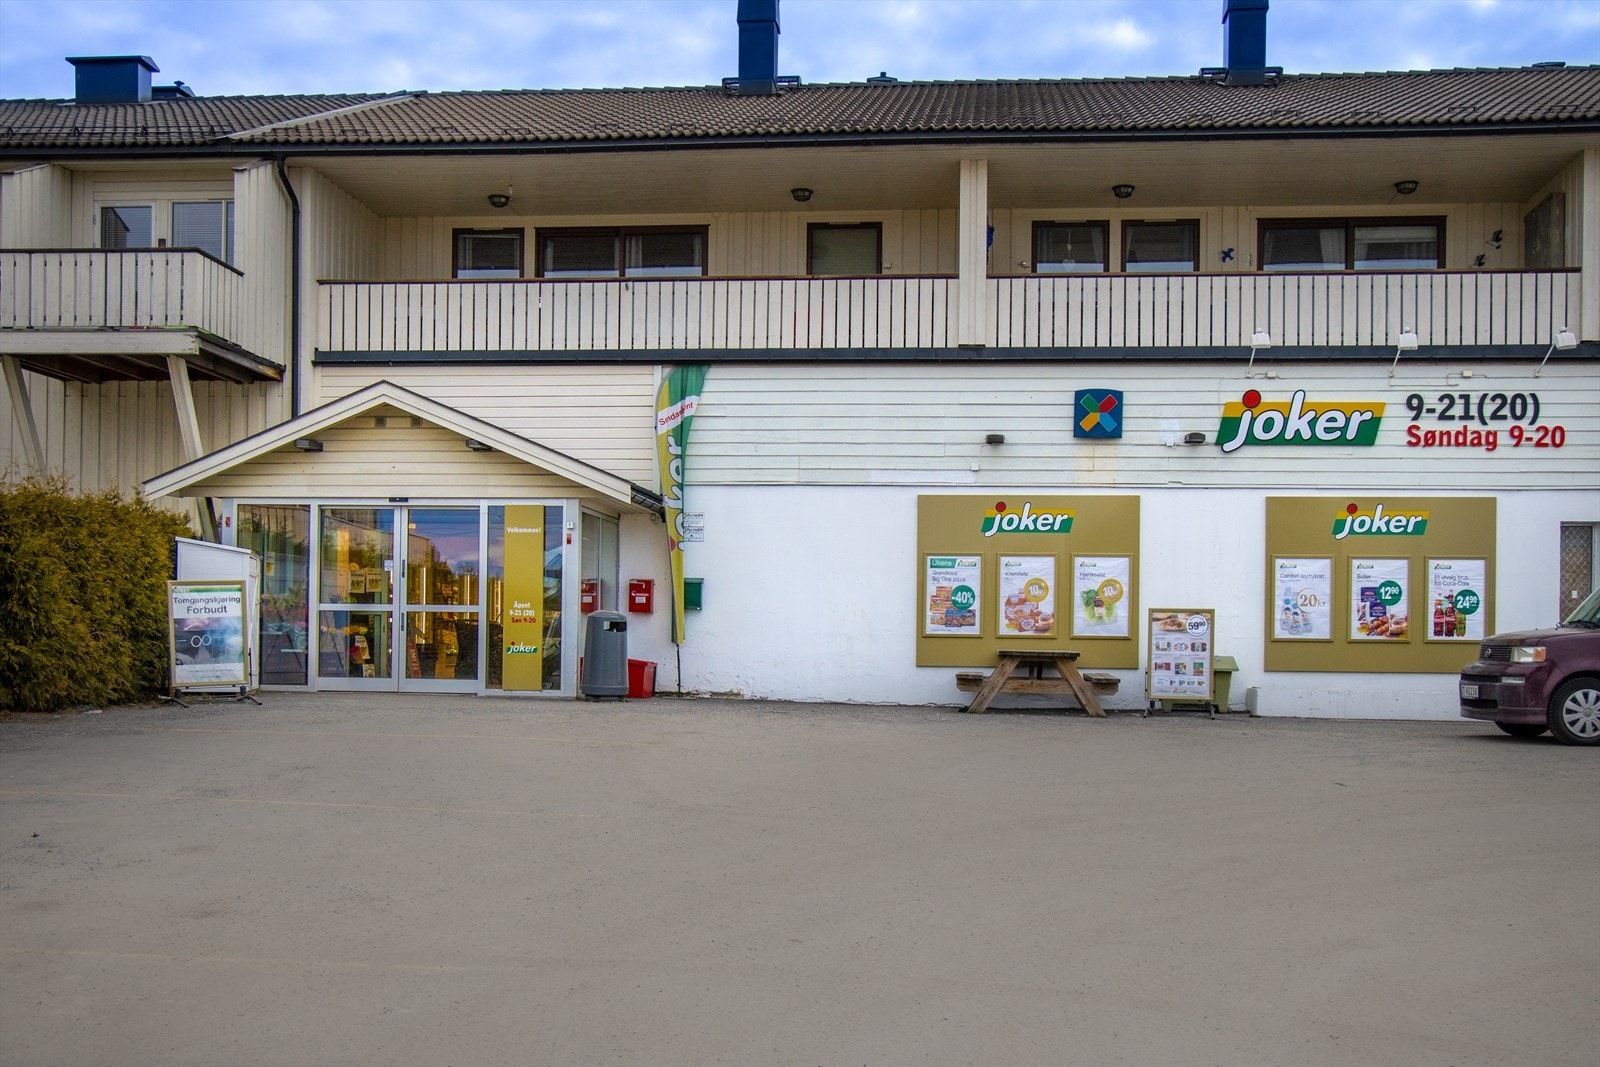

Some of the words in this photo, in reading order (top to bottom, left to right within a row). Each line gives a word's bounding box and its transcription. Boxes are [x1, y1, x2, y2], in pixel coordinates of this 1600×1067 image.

[1406, 393, 1540, 425] 9-21(20)
[1221, 389, 1373, 452] joker
[1406, 424, 1498, 450] Søndag
[1509, 425, 1565, 448] 9-20
[984, 501, 1069, 537] joker
[1335, 503, 1422, 540] joker
[931, 559, 953, 567] Ukens
[173, 596, 241, 605] Tomgangskjøring
[951, 591, 974, 604] -40%
[186, 605, 228, 614] Forbudt
[513, 601, 531, 609] Åpent
[507, 641, 537, 654] joker
